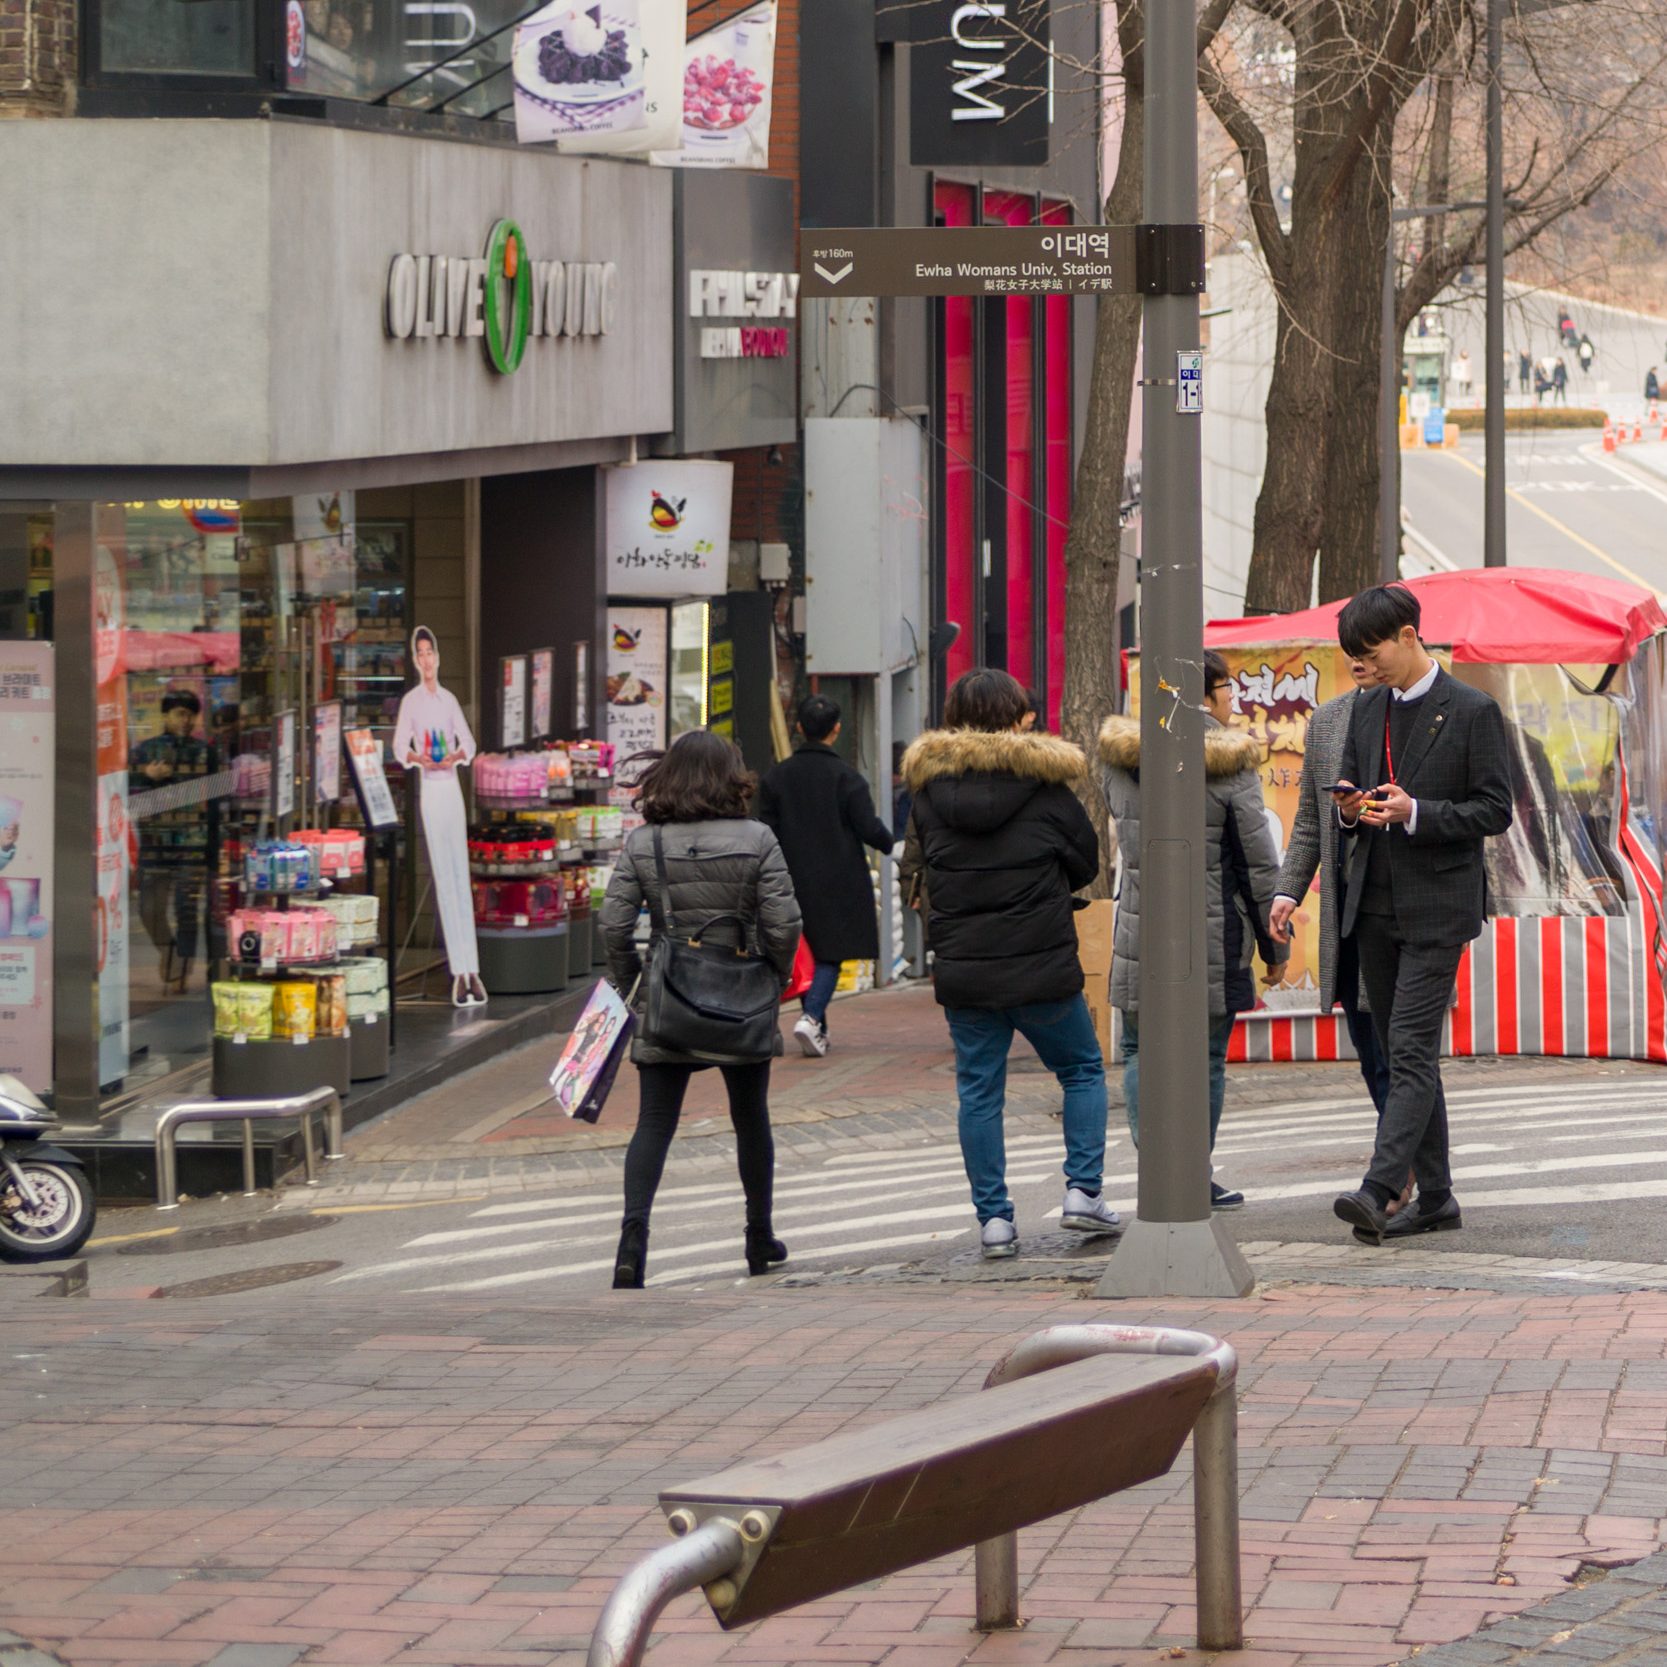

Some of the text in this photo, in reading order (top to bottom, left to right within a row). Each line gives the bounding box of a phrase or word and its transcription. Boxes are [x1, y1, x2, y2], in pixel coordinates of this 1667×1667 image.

[1040, 232, 1110, 259] 이대역
[915, 261, 1112, 278] Ewha Womans Univ. Station
[983, 277, 1113, 291] 梨花女子大学站 イデ駅
[387, 252, 617, 339] OLIVE YOUNG
